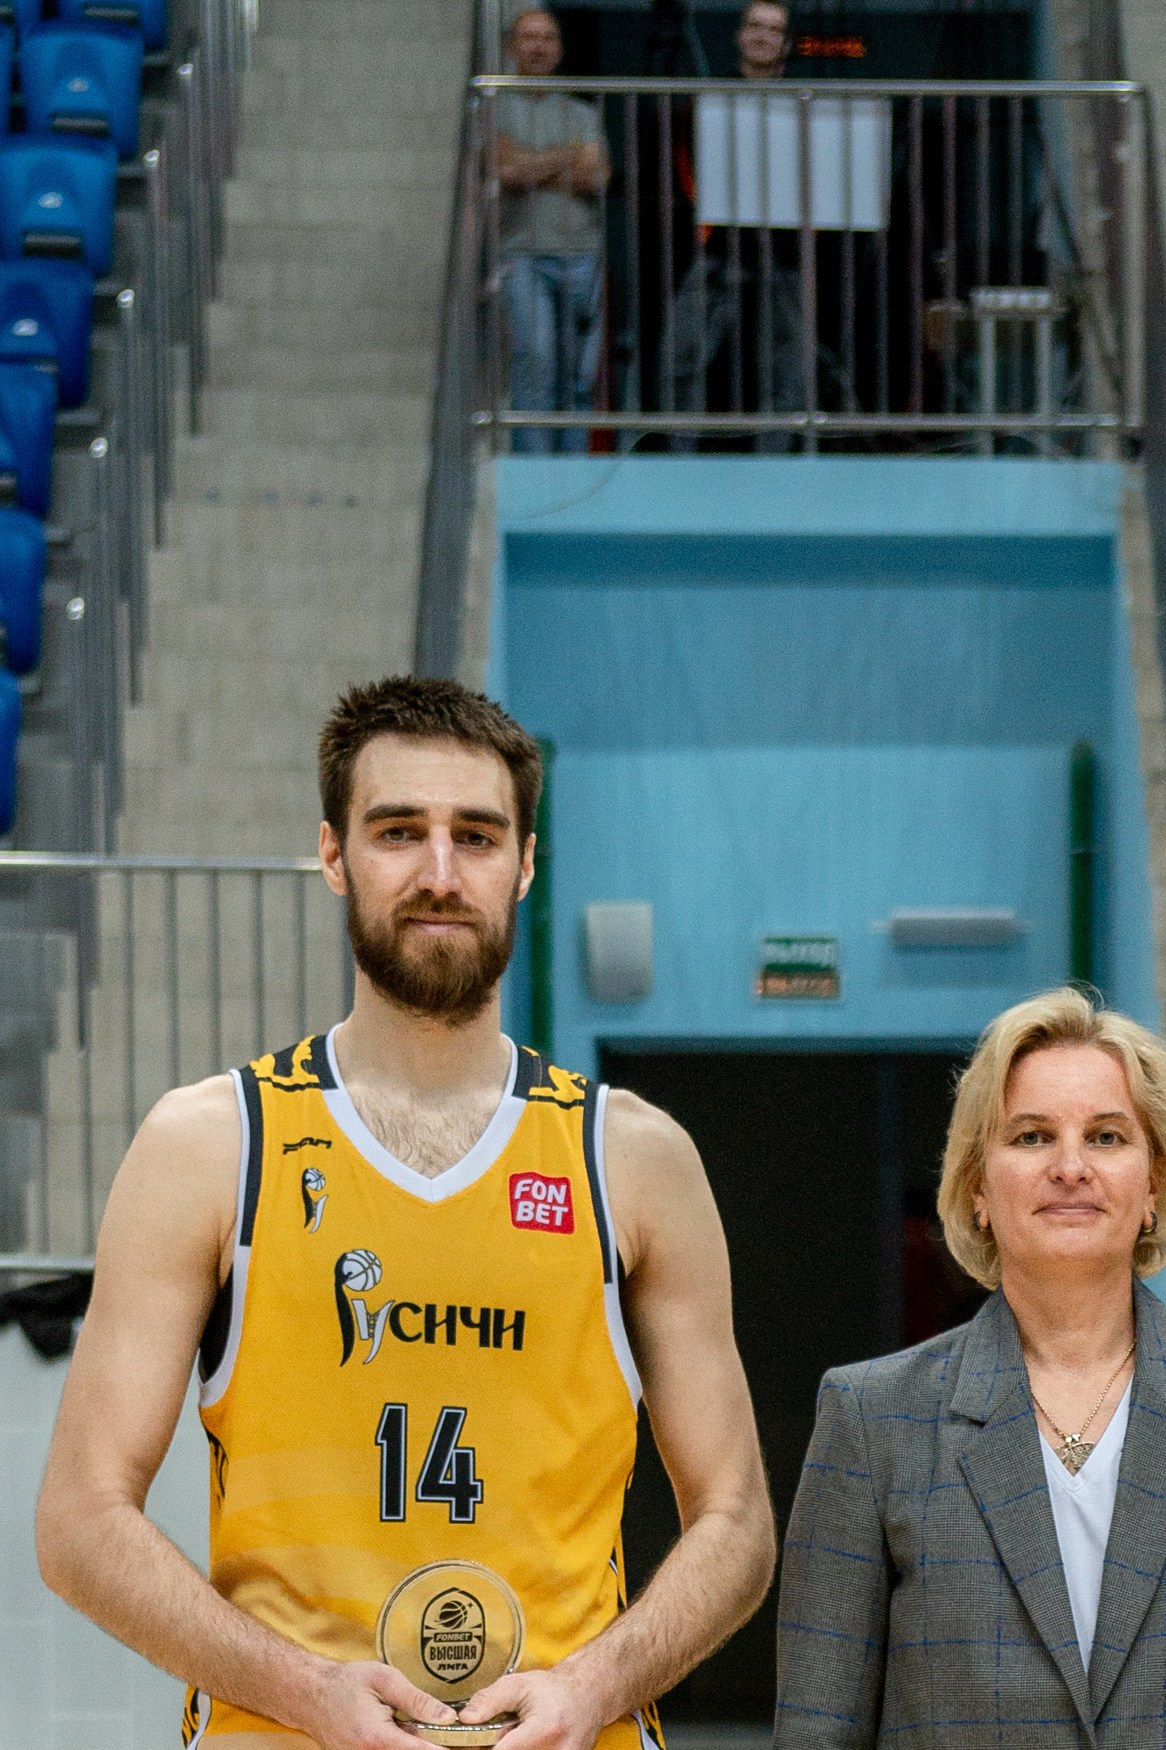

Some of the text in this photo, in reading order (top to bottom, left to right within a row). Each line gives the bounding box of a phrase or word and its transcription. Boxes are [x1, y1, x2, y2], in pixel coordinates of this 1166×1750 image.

[514, 1179, 567, 1204] FON
[516, 1201, 569, 1226] BET
[375, 1402, 484, 1524] 14
[435, 1633, 471, 1641] FONBET
[429, 1645, 477, 1661] ВЫСШАЯ
[437, 1663, 468, 1671] ЛИГА
